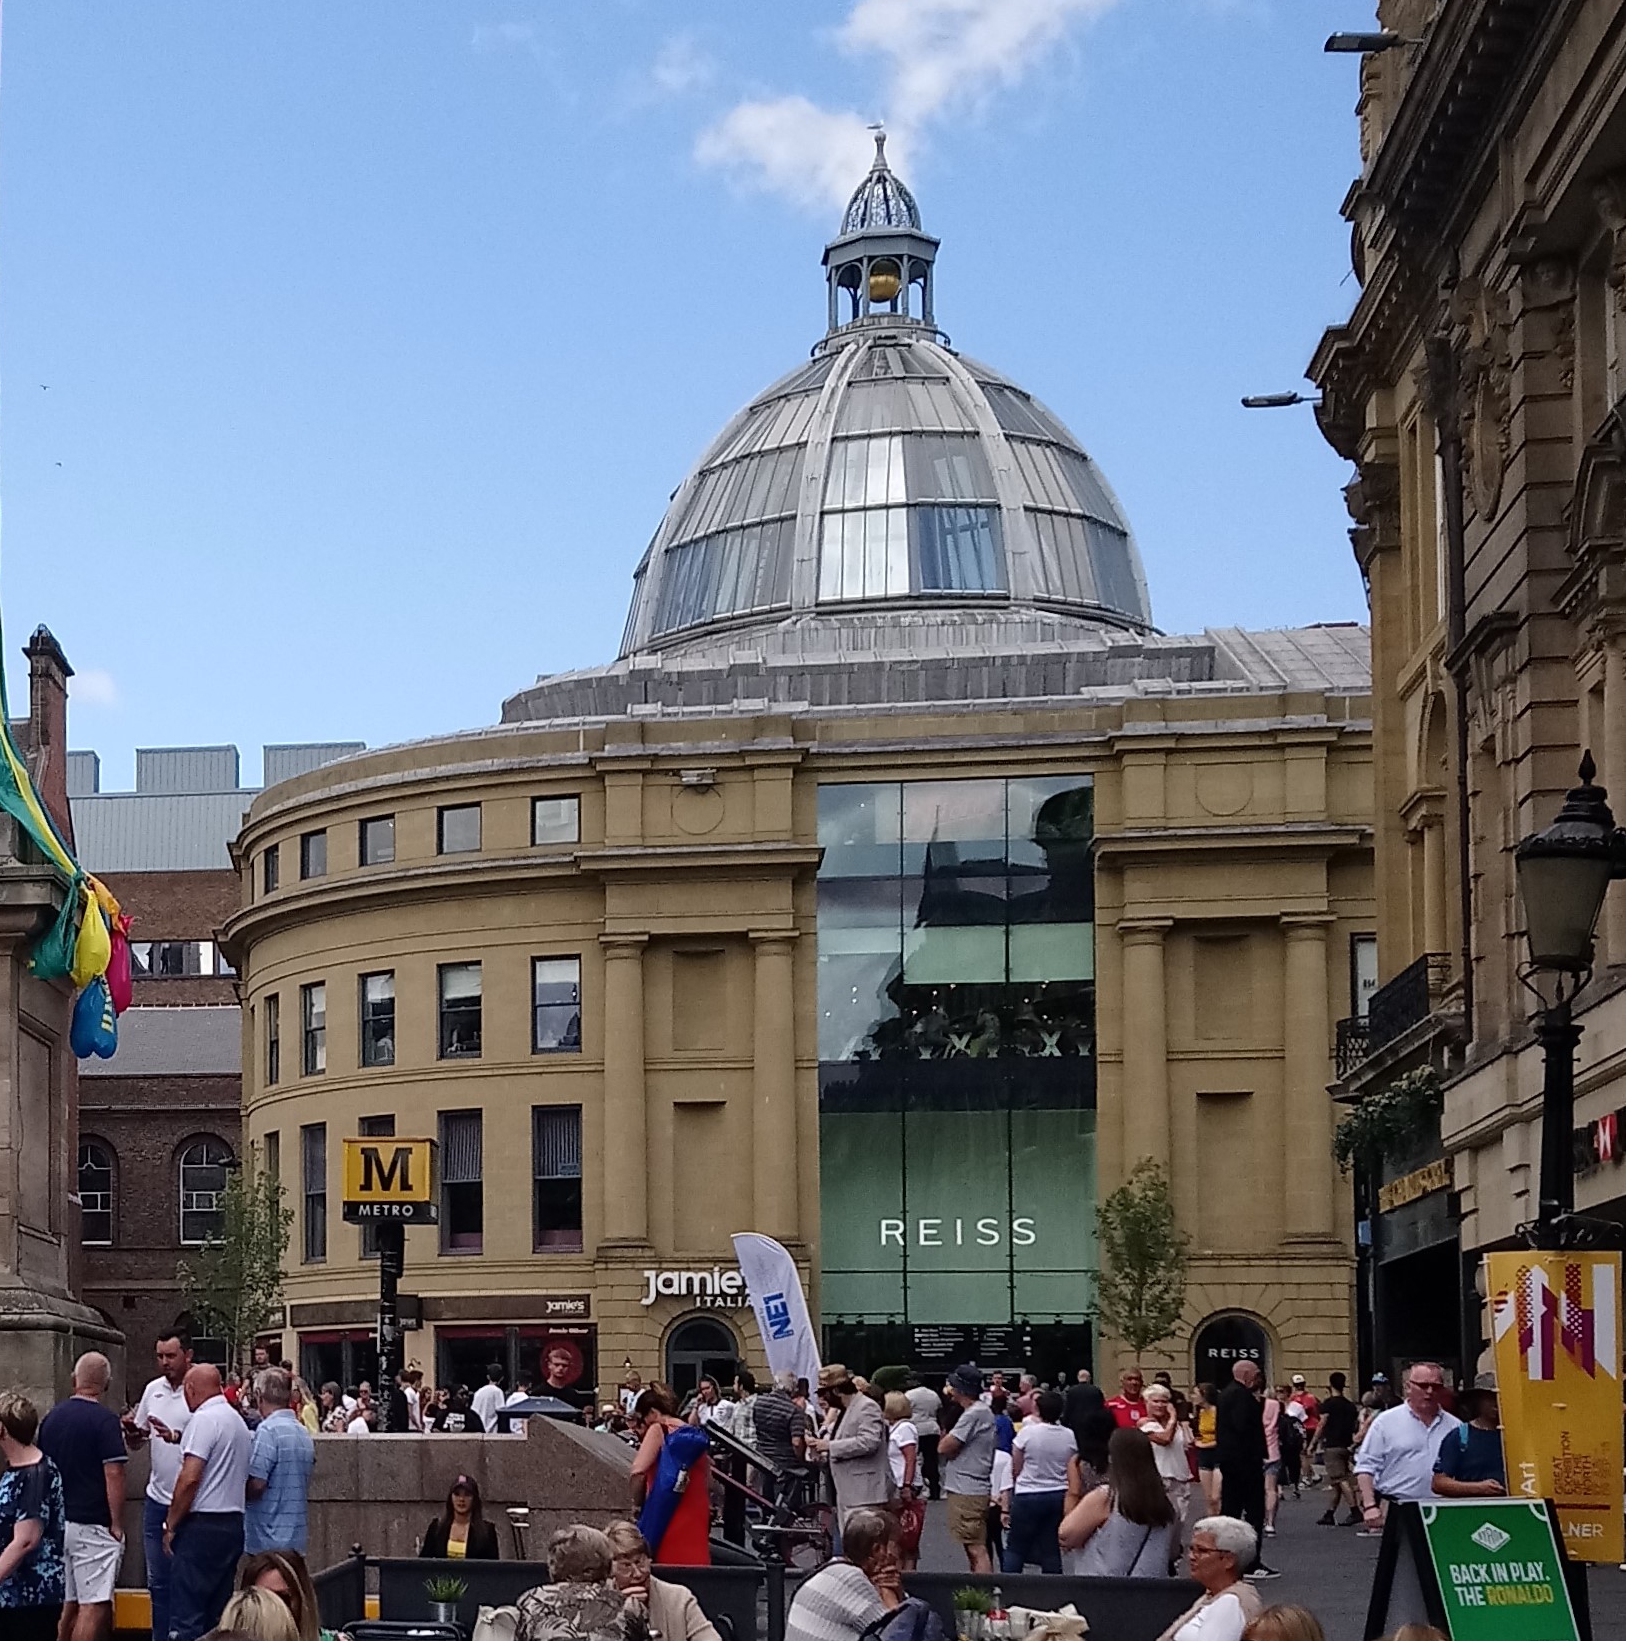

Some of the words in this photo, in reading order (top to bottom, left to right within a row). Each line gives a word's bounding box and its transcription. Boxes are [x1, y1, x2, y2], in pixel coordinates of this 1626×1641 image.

[359, 1147, 413, 1192] M
[358, 1204, 414, 1217] METRO
[880, 1218, 1037, 1246] REISS
[695, 1295, 755, 1308] ITALIA
[1207, 1347, 1260, 1359] REISS
[1518, 1461, 1538, 1495] Art
[1449, 1563, 1492, 1585] BACK
[1491, 1562, 1510, 1583] IN
[1509, 1561, 1551, 1583] PLAY.
[1454, 1586, 1487, 1607] THE
[1486, 1583, 1555, 1606] RONALDO
